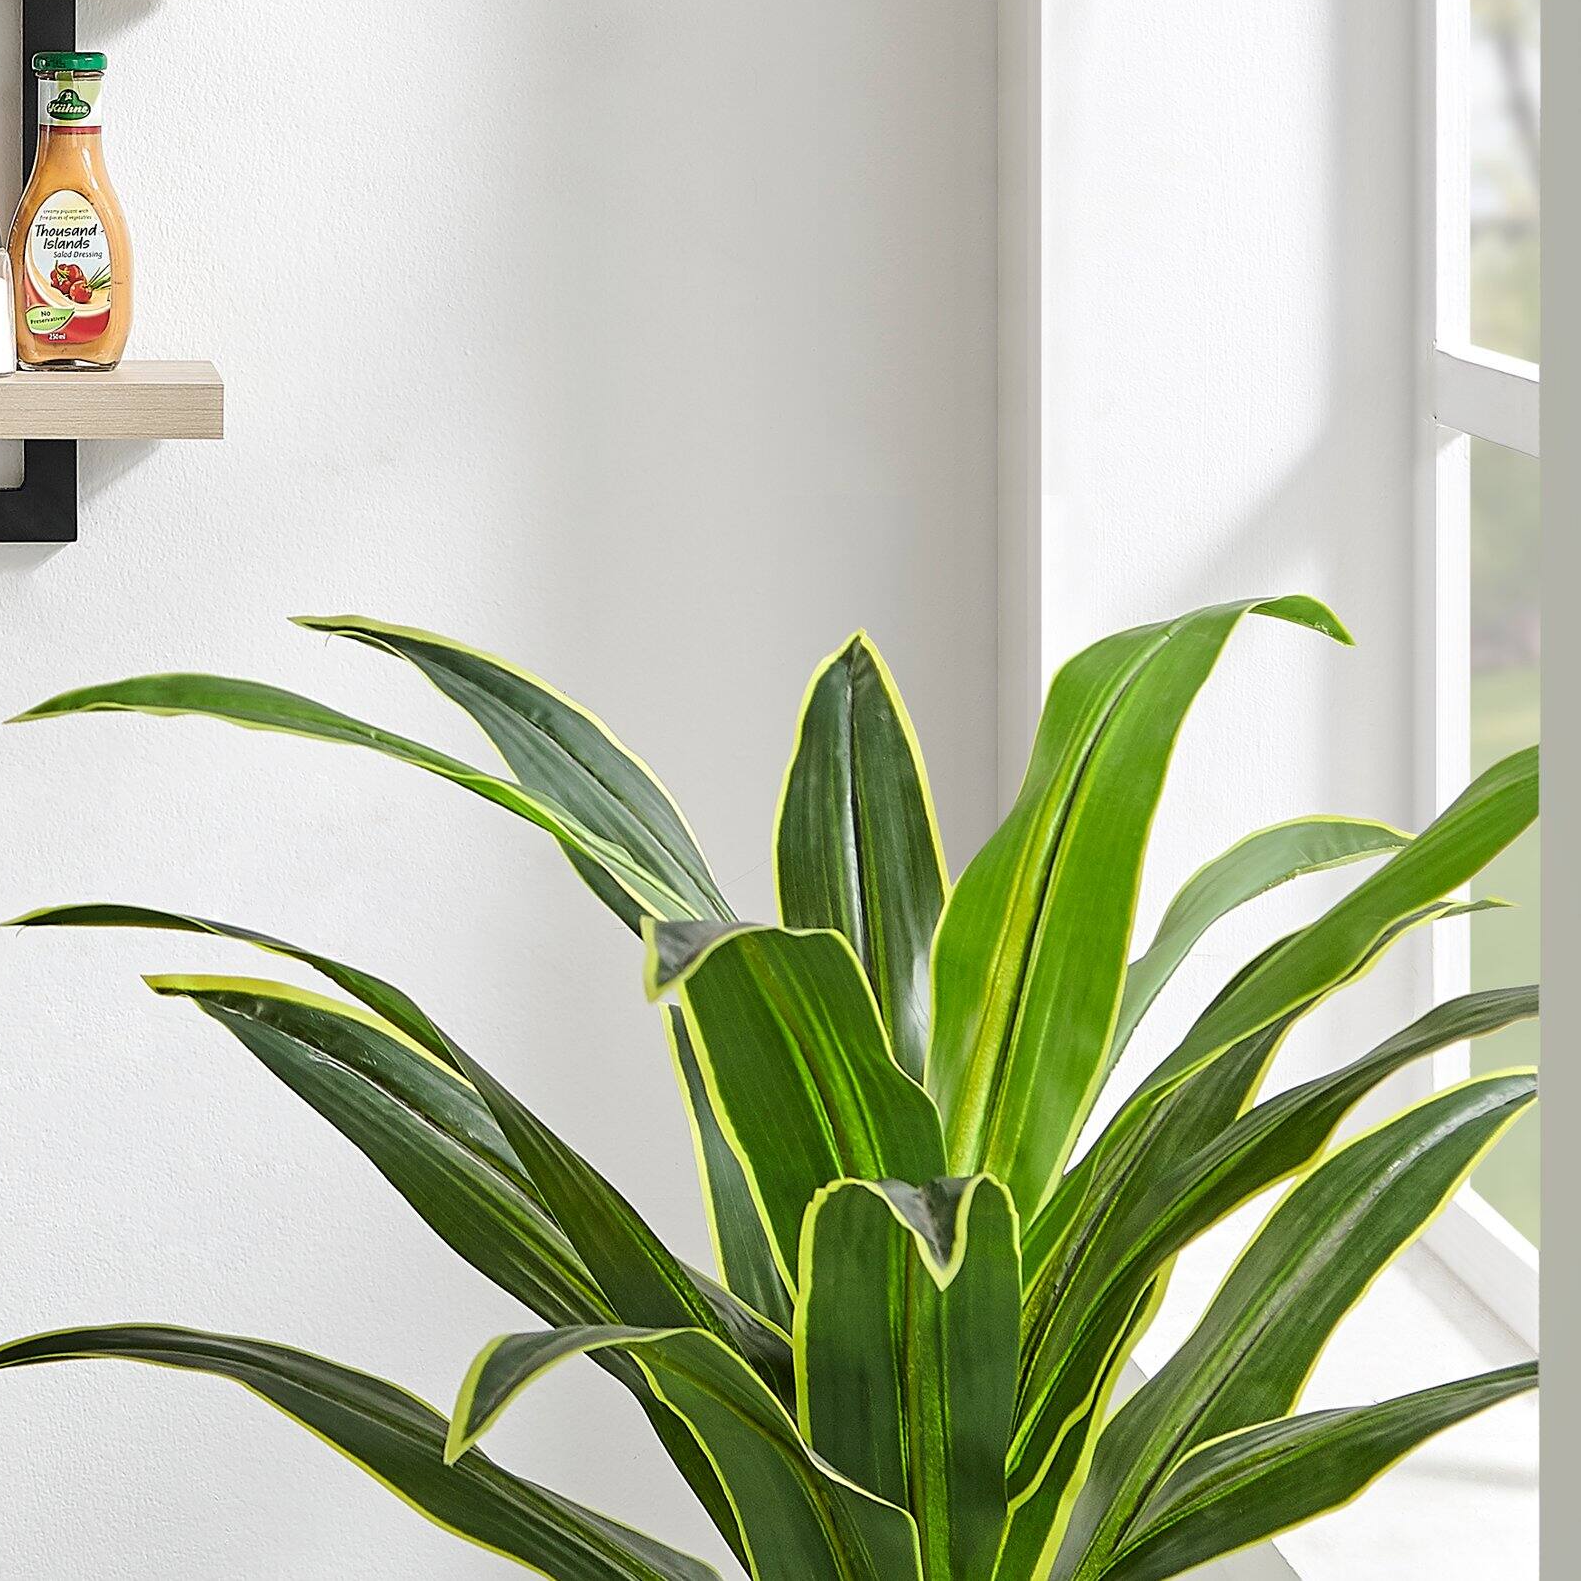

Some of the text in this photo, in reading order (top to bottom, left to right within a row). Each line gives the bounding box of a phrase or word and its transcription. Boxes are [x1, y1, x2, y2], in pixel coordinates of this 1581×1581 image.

[35, 223, 98, 237] Thousand
[43, 237, 90, 250] Islands
[53, 250, 103, 259] Salad Dressing
